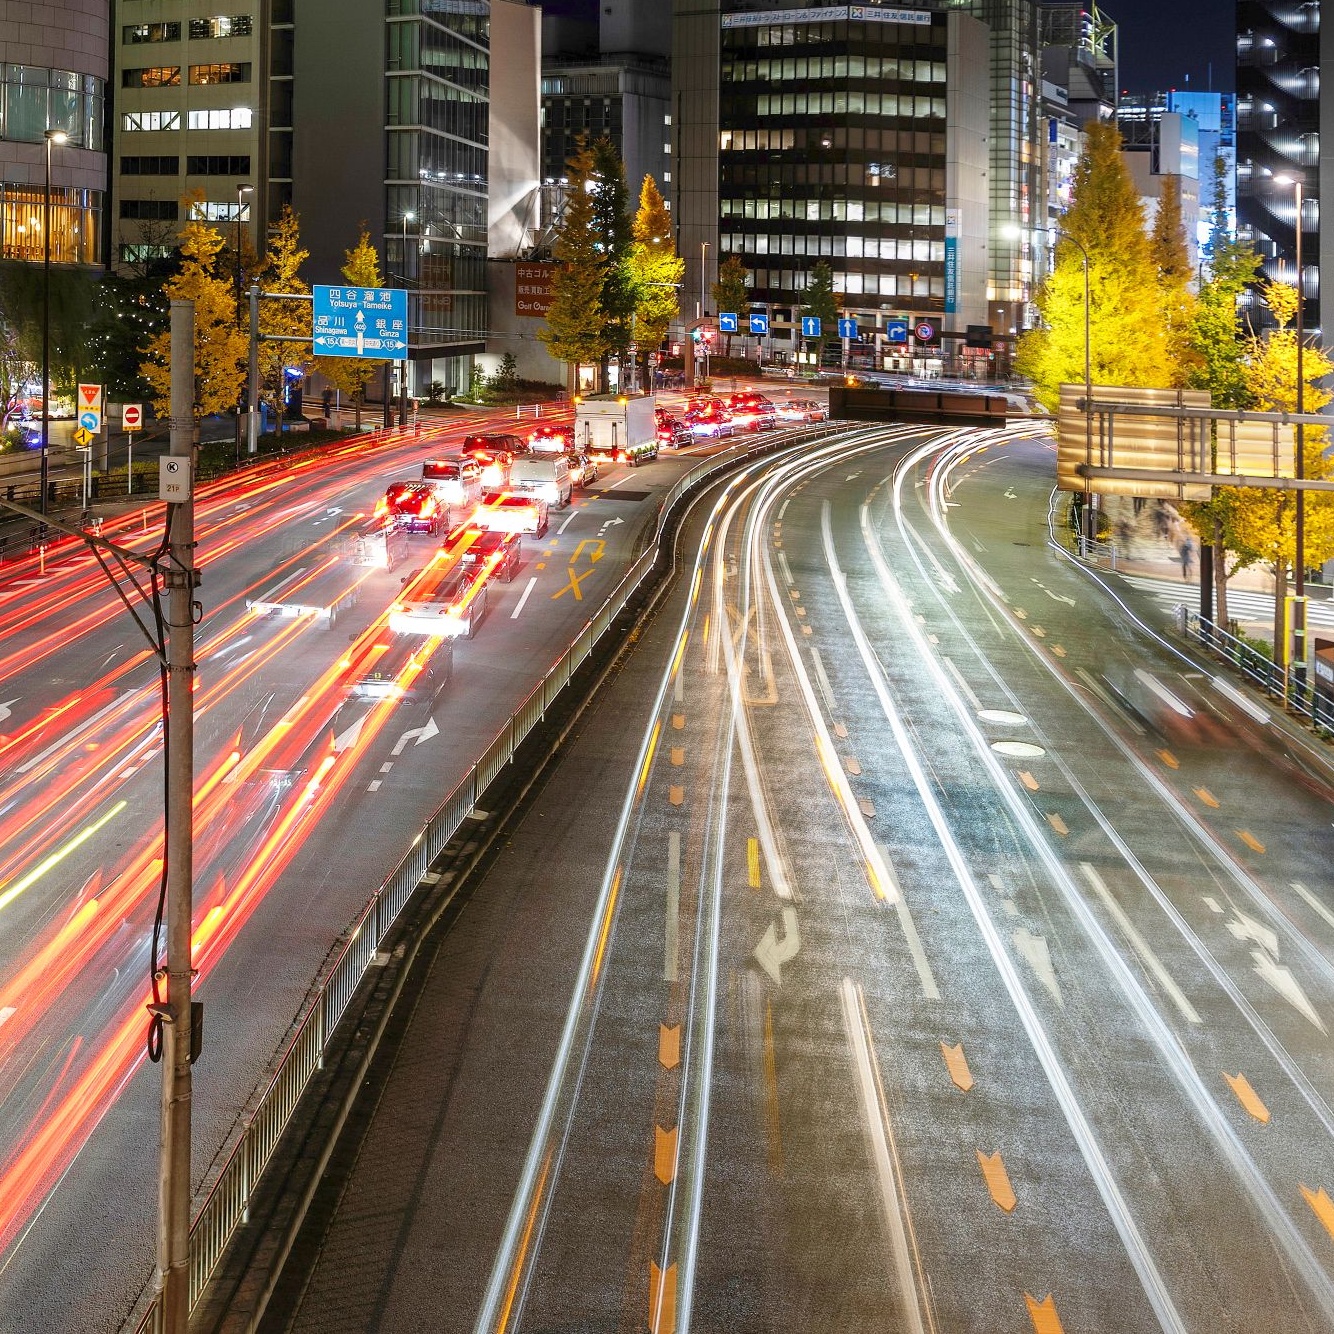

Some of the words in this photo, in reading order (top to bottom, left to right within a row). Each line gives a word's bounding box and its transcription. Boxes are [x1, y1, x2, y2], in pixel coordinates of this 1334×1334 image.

[867, 10, 931, 22] 三井住友信託銀行
[329, 299, 357, 309] Yotsuya
[362, 301, 392, 310] Tameike
[517, 300, 532, 310] Golf
[317, 315, 345, 326] 品川
[375, 319, 403, 330] 銀座
[315, 326, 348, 335] Shinagawa
[379, 329, 399, 338] Ginza
